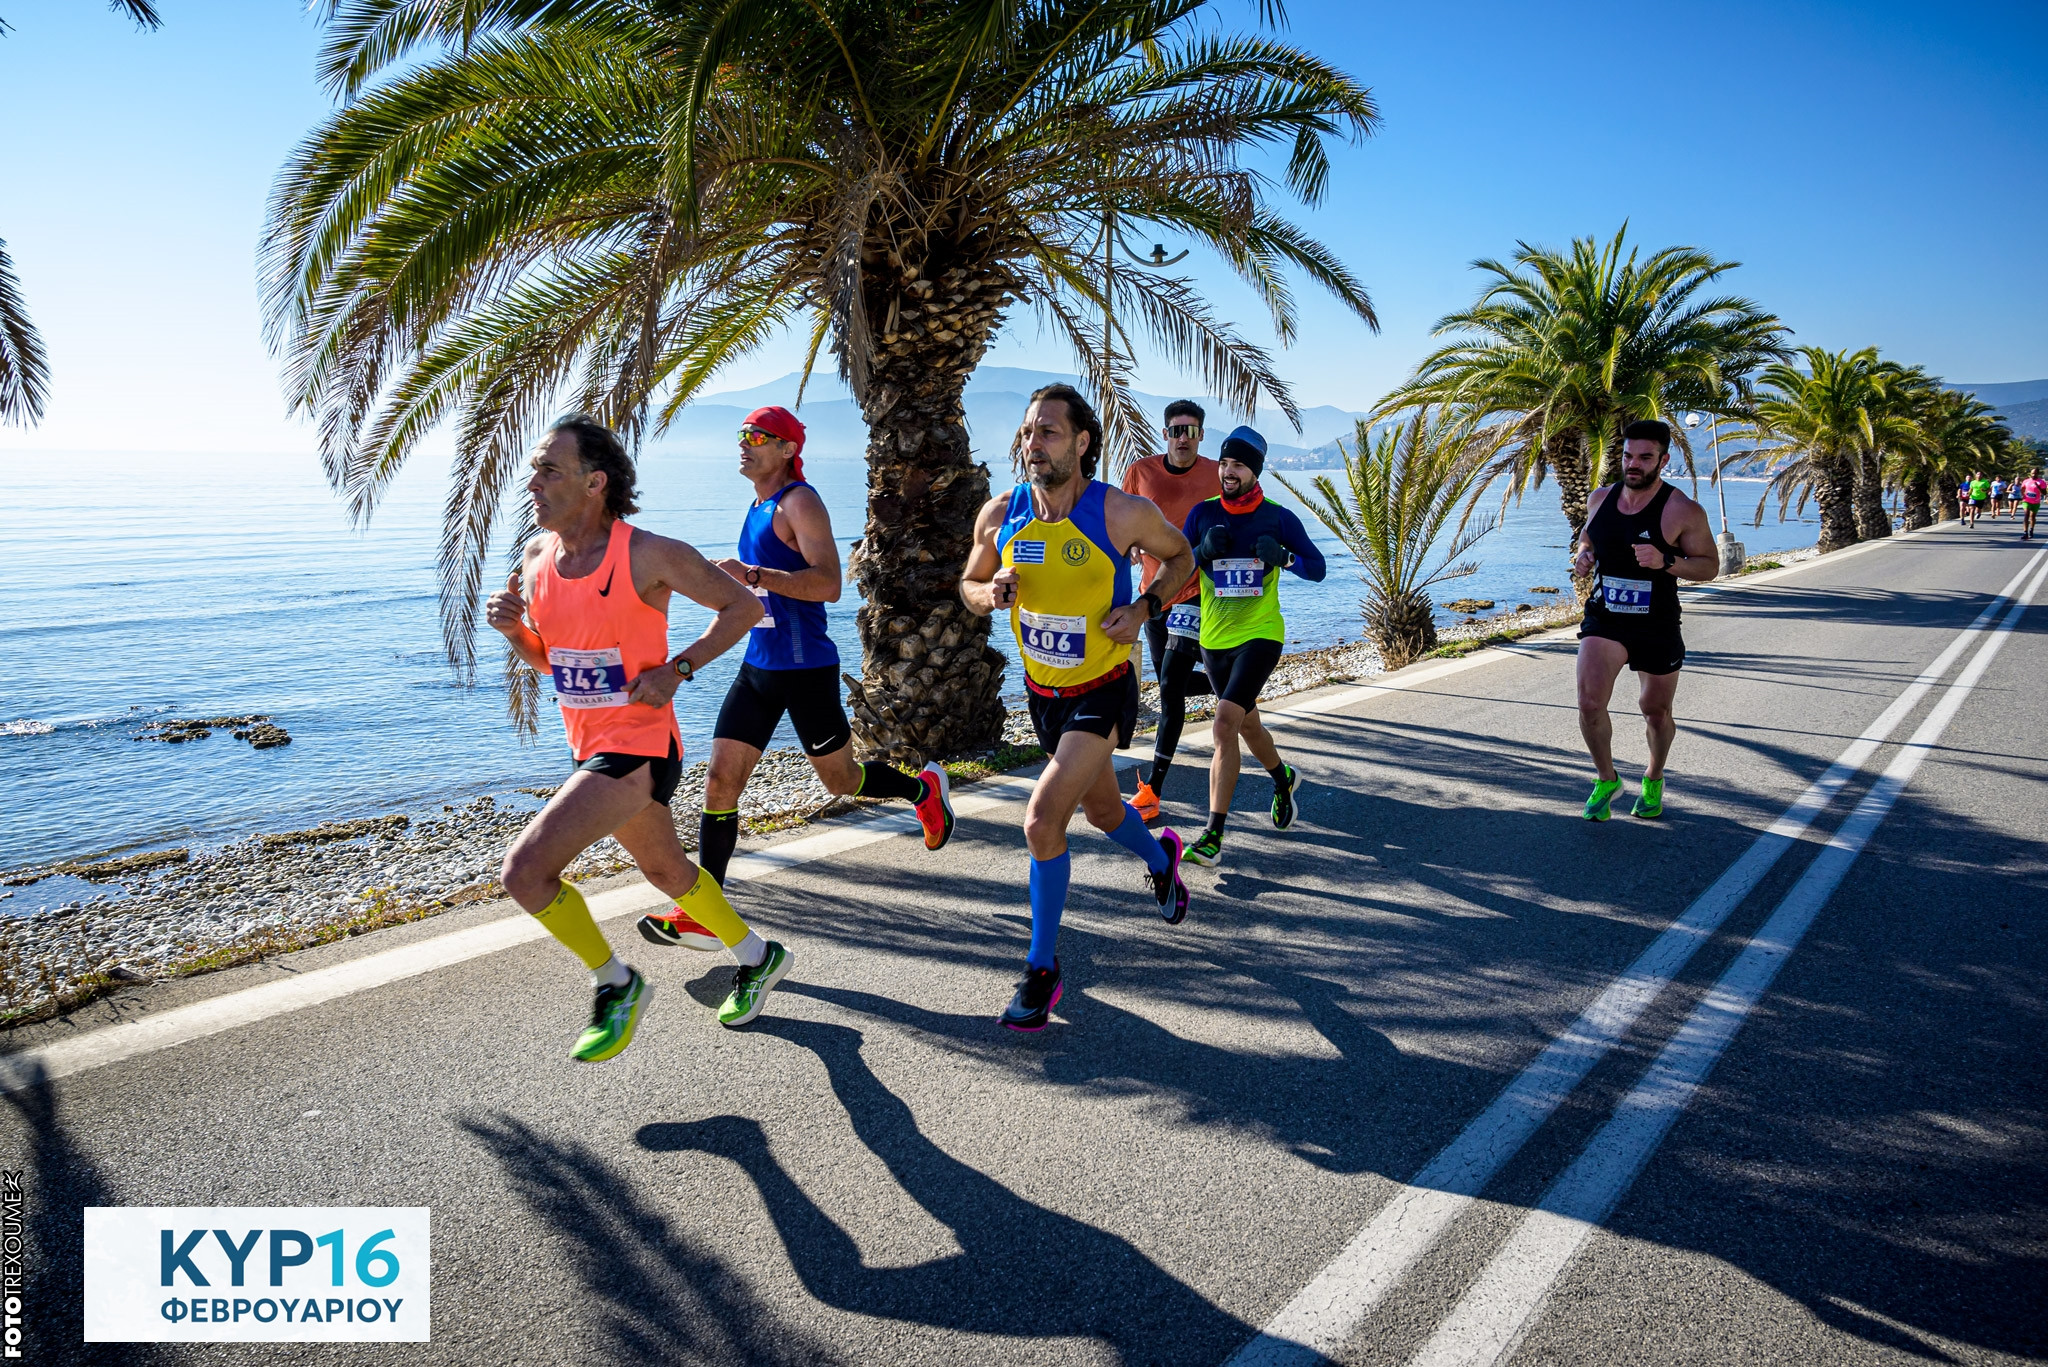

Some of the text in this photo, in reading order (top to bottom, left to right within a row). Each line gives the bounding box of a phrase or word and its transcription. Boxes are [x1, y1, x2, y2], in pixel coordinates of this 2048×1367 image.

[1225, 571, 1254, 584] 113
[1608, 589, 1639, 603] 861
[1173, 614, 1199, 629] 234
[1028, 629, 1070, 652] 606
[1037, 653, 1070, 665] MAKARIS
[562, 668, 610, 690] 342
[573, 696, 613, 704] MAKARIS
